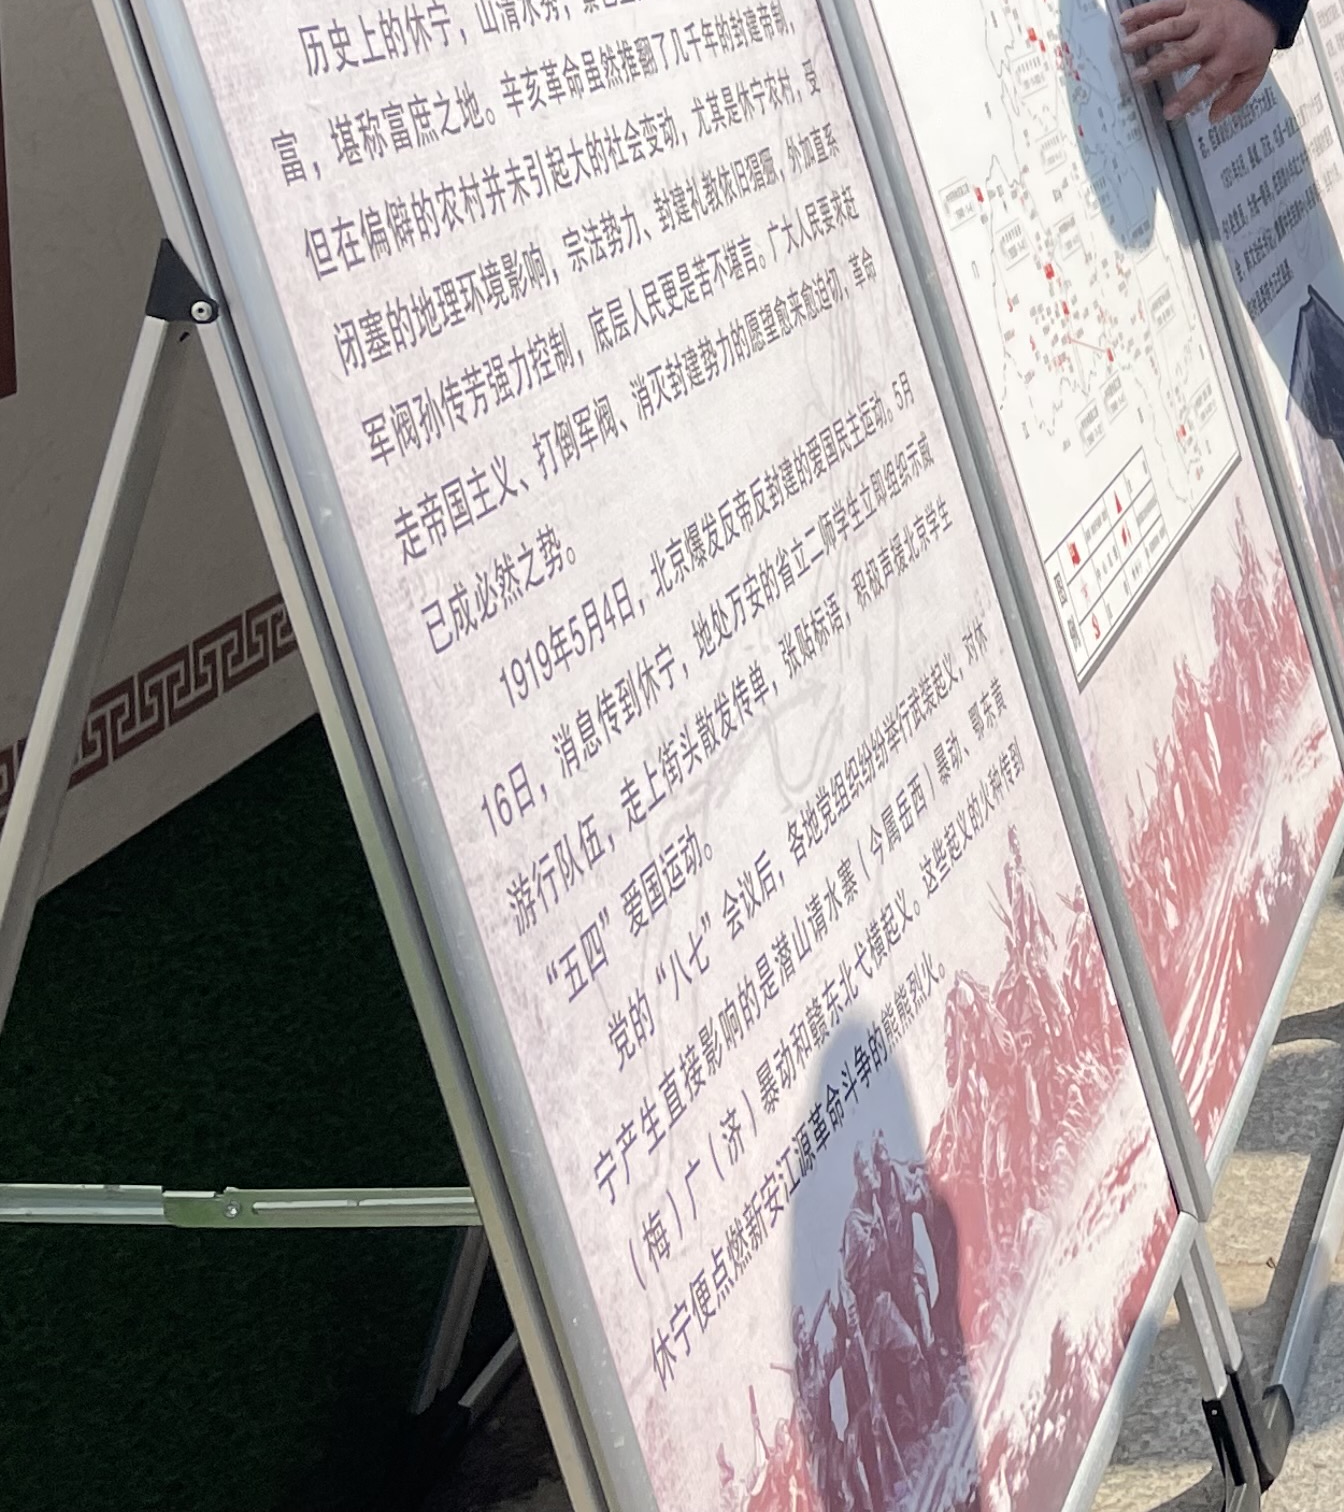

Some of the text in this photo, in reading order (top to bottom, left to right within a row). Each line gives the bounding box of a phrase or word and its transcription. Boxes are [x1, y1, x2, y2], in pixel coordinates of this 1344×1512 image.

[301, 57, 822, 288] 但在偏僻的农村并未引起大的社会变动，尤其是休宁农村，受
[360, 184, 860, 469] 军阀孙传芳强力控制，底层人民更是苦不堪言。广大人民要求赶
[389, 245, 879, 567] 走帝国主义、打倒军阀、消灭封建势力的愿望愈来愈迫切，革命
[495, 370, 916, 714] 1919年5月4日，北京爆发反帝反封建的爱国民主运动。5月
[420, 522, 580, 660] 已成必然之势。
[477, 430, 935, 844] 16日，消息传到休宁，地处万安的省立二师学生立即组织示威
[504, 492, 954, 939] 游行队伍，走上街头散发传单，张贴标语，积极声援北京学生
[642, 956, 946, 1390] 休宁便点燃新安江源革命斗争的熊熊烈火。
